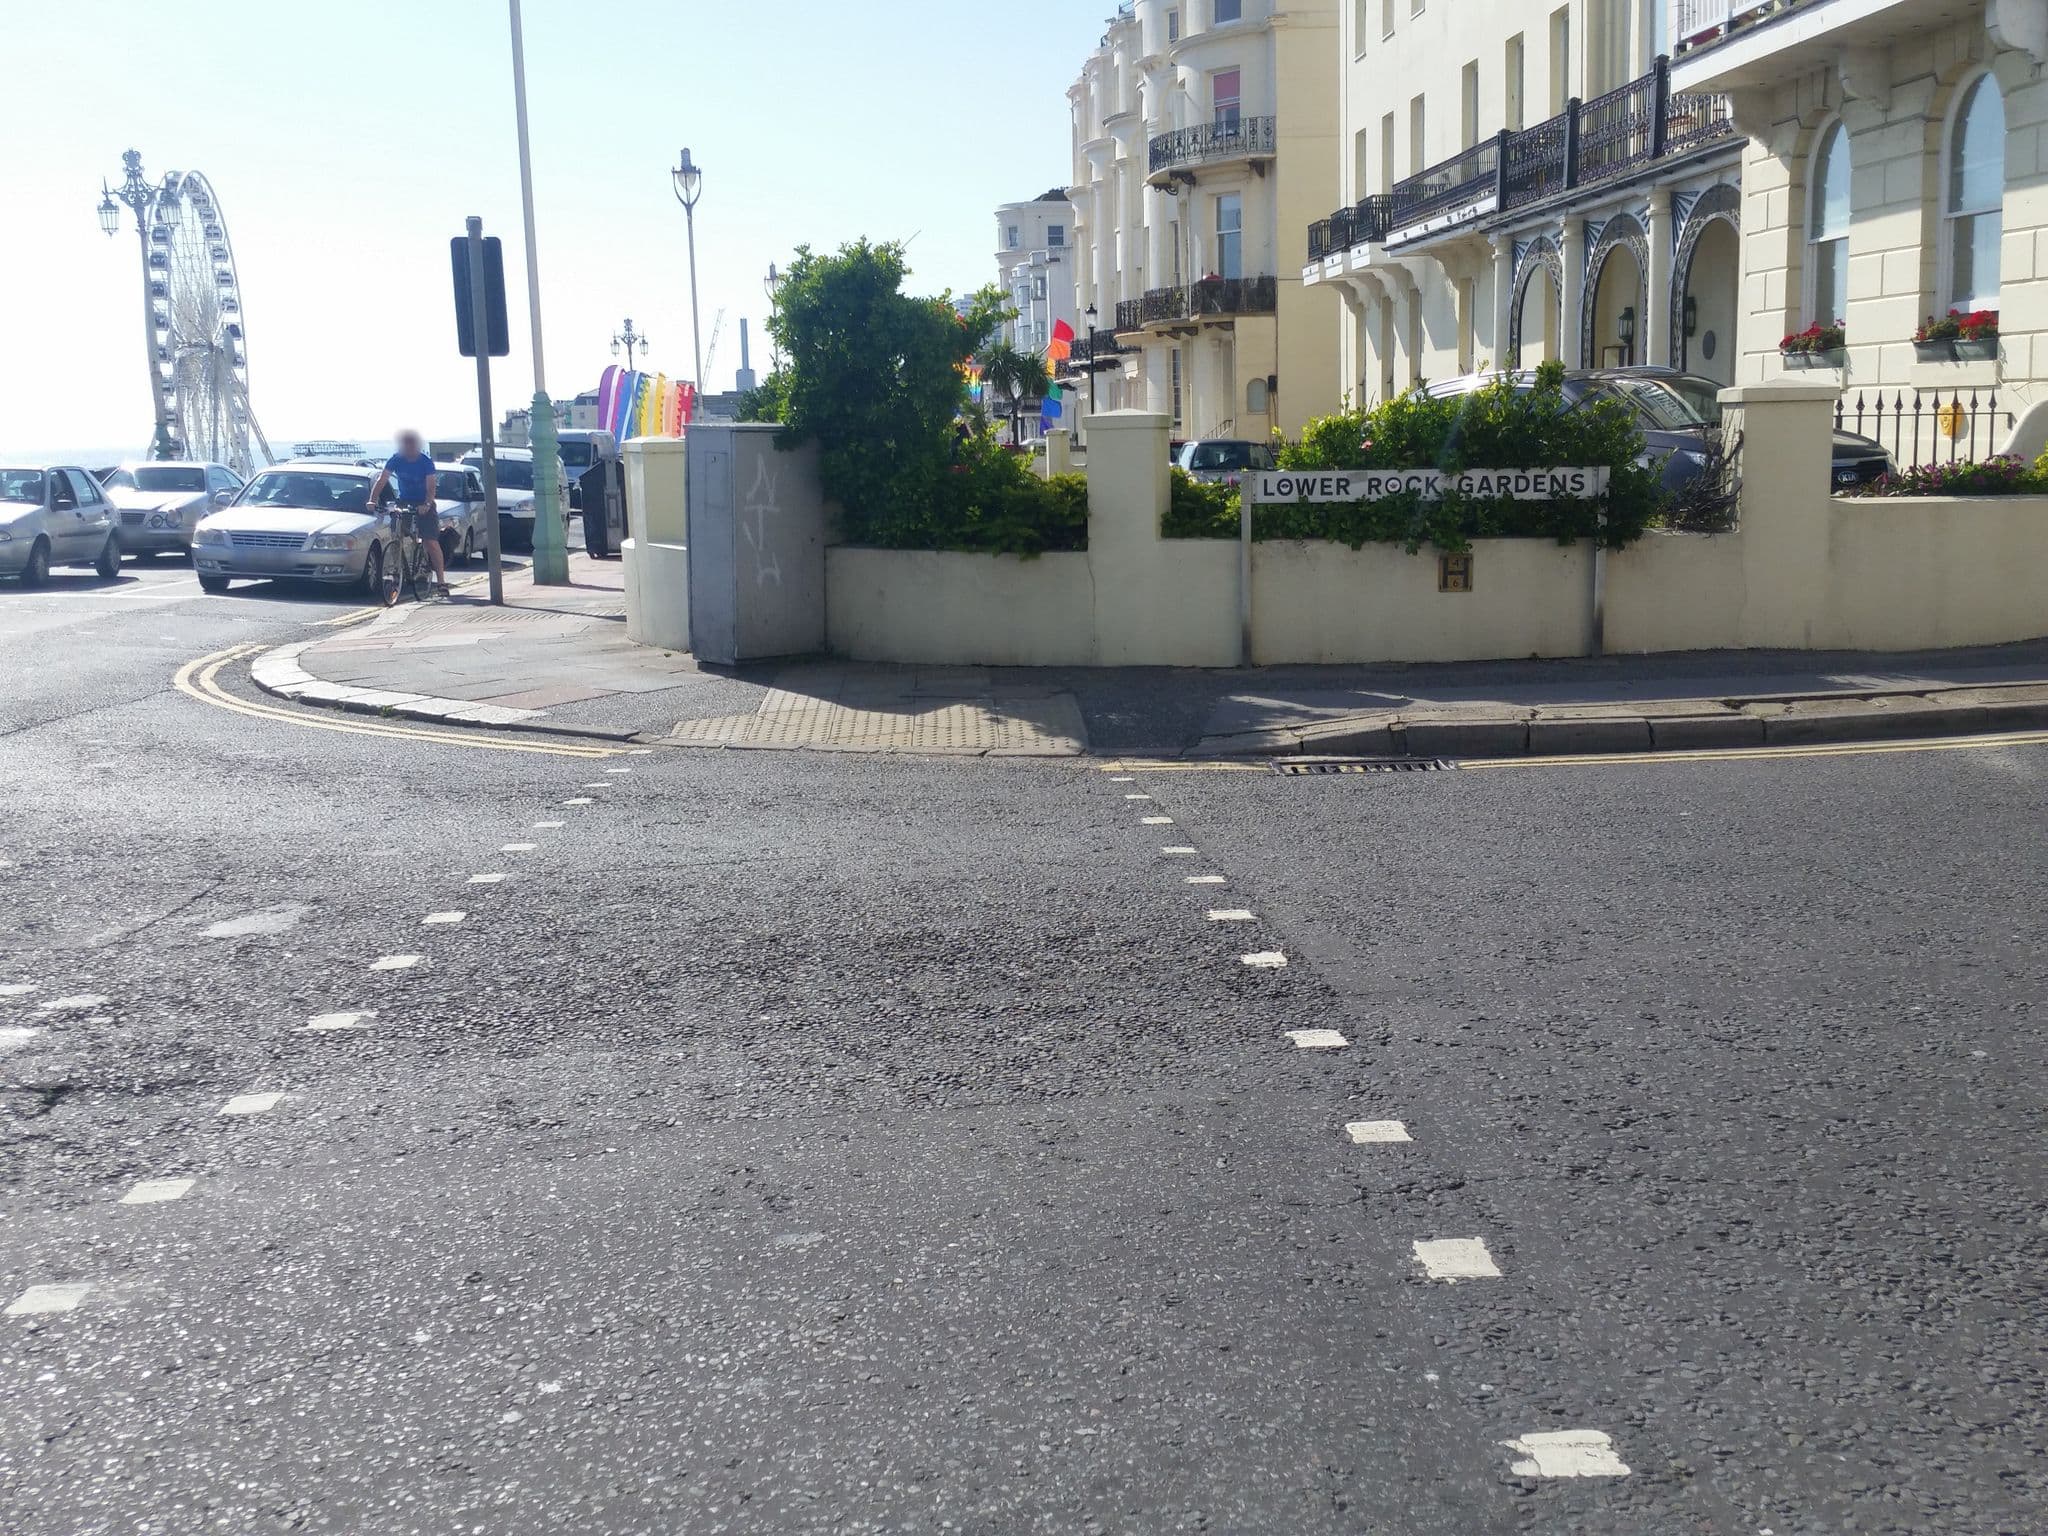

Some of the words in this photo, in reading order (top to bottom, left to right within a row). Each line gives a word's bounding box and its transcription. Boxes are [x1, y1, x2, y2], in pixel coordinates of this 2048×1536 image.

[1263, 477, 1350, 496] LOWER
[1367, 476, 1441, 496] ROCK
[1457, 473, 1585, 494] GARDENS
